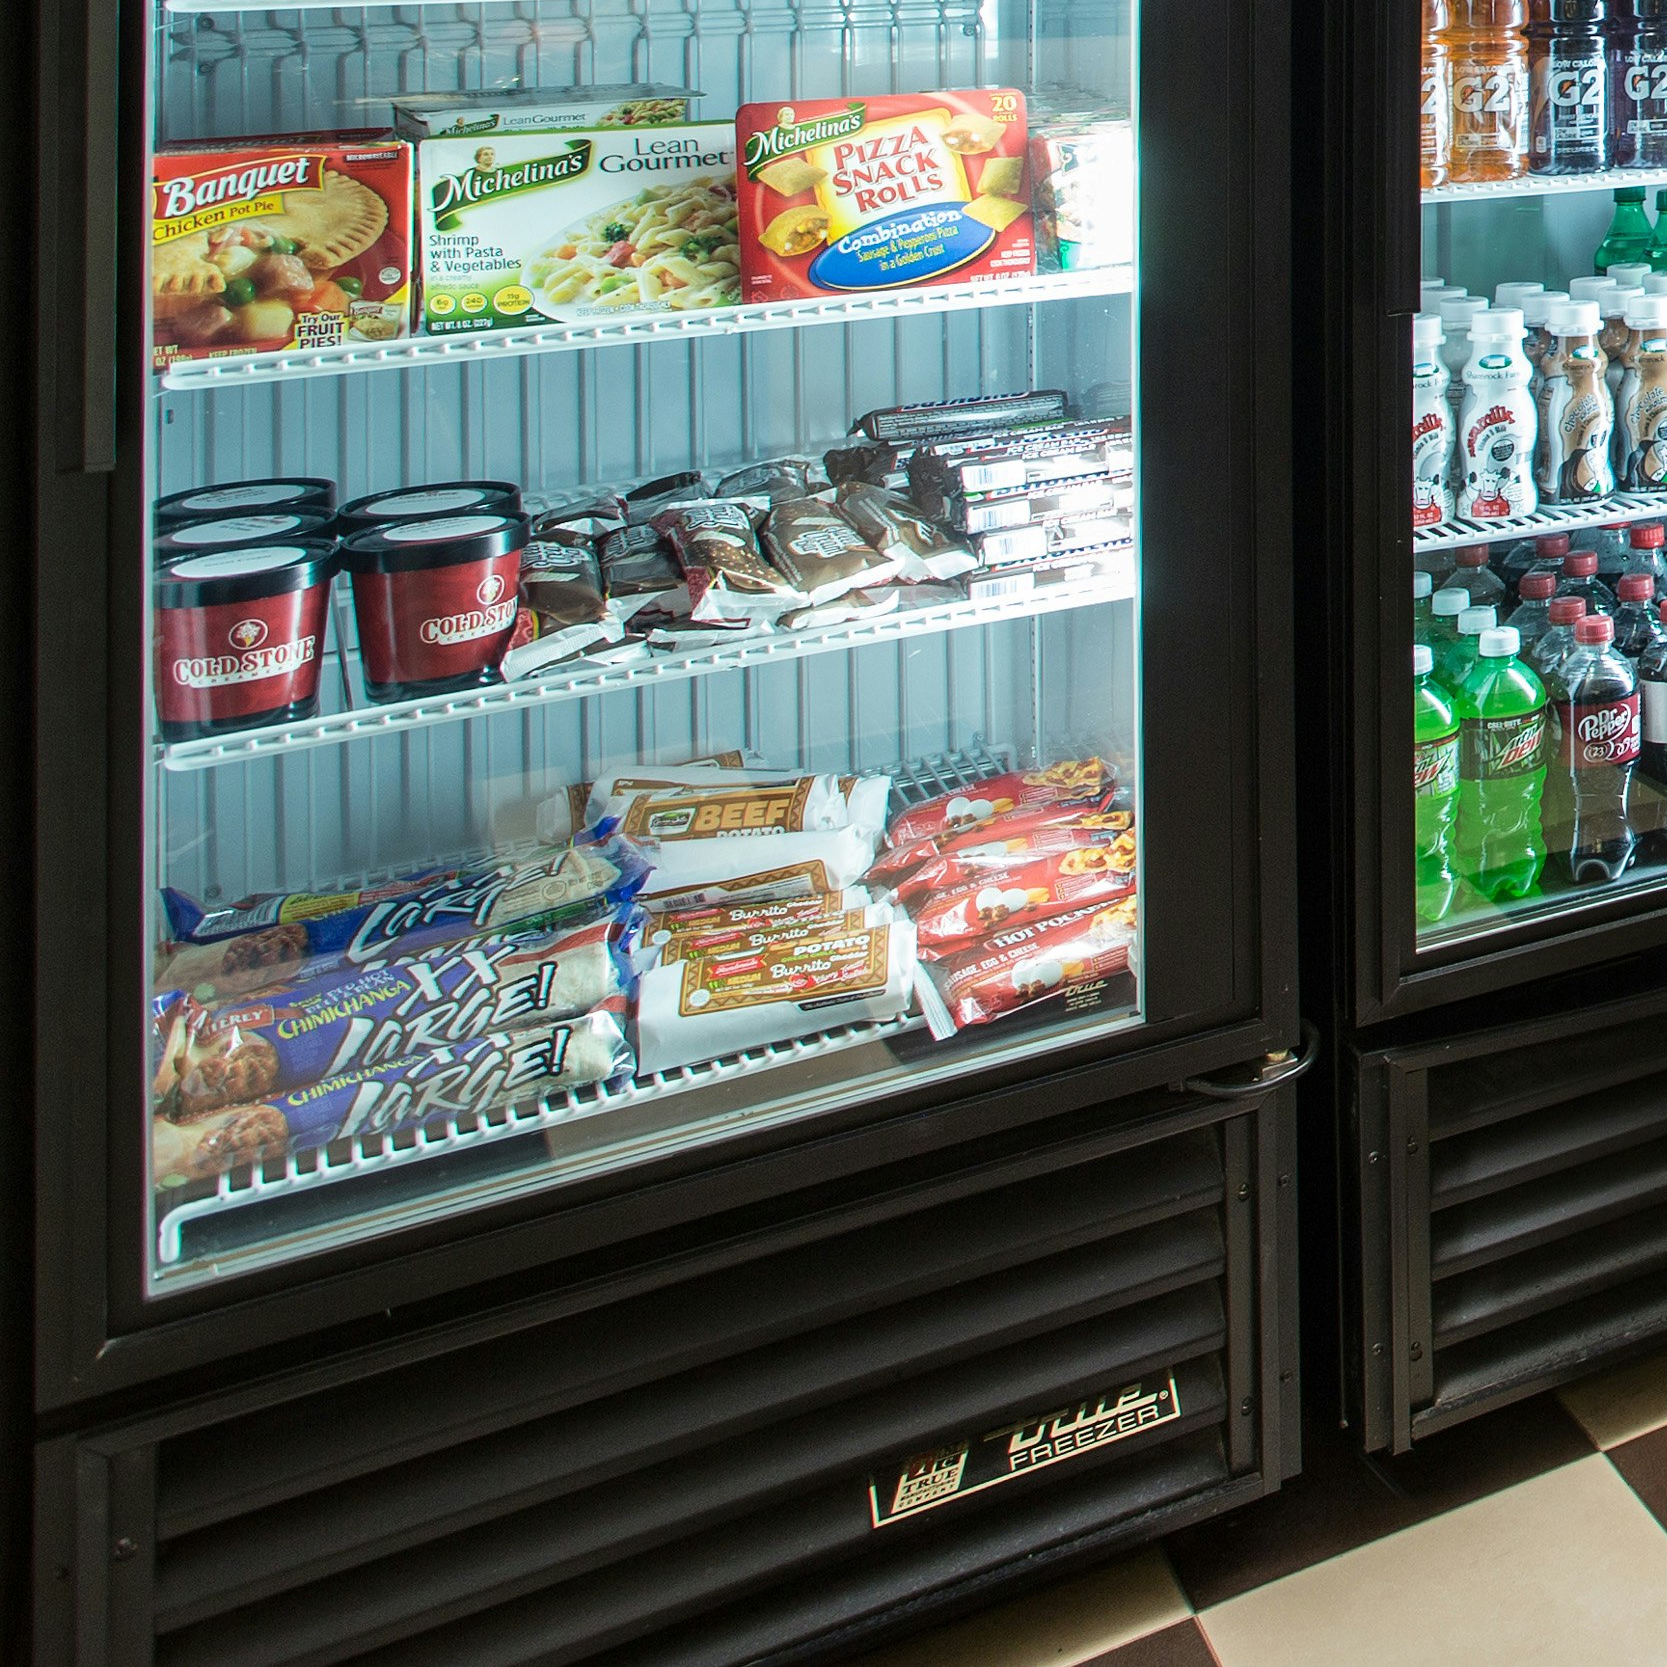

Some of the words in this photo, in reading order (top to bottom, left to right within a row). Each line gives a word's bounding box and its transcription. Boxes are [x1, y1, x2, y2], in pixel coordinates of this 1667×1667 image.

[991, 95, 1018, 113] 20
[1454, 75, 1511, 113] G2
[503, 114, 532, 126] Lean
[532, 112, 587, 124] Gourmet
[993, 113, 1018, 122] ROLLS
[633, 137, 700, 157] Lean
[743, 111, 863, 166] Michelina's
[833, 125, 929, 172] PIZZA
[599, 149, 730, 174] Gourmet
[832, 151, 940, 198] SNACK
[164, 156, 311, 219] Banquet
[427, 152, 584, 213] Michelina's
[855, 173, 944, 214] ROLLS
[153, 210, 227, 242] Chicken
[229, 205, 251, 219] Pot
[254, 200, 275, 213] Pie
[838, 208, 963, 255] Combination
[429, 234, 480, 248] Shrimp
[430, 247, 461, 259] with
[465, 245, 504, 259] Pasta
[430, 261, 443, 274] &
[445, 258, 522, 275] Vegetables
[297, 321, 346, 338] FRUIT
[301, 314, 319, 325] Try
[320, 313, 341, 323] Our
[298, 336, 343, 350] PIES!
[1630, 386, 1665, 426] chocolate
[420, 610, 486, 646] COLD
[174, 651, 236, 686] COLD
[236, 634, 317, 675] STONE
[1577, 701, 1631, 744] Pepper
[1597, 707, 1618, 724] Dr
[1590, 747, 1605, 758] 23
[699, 797, 792, 828] BEEF
[728, 906, 789, 922] Burrito
[748, 927, 810, 947] Burrito
[793, 934, 871, 956] POTATO
[992, 926, 1036, 949] HOT
[981, 956, 999, 971] EGG
[1009, 941, 1041, 960] CHEESE
[769, 960, 833, 980] Burrito
[276, 979, 412, 1041] CHIMICHANGA
[1009, 1405, 1160, 1472] FREEZER
[901, 1466, 960, 1494] TRUE
